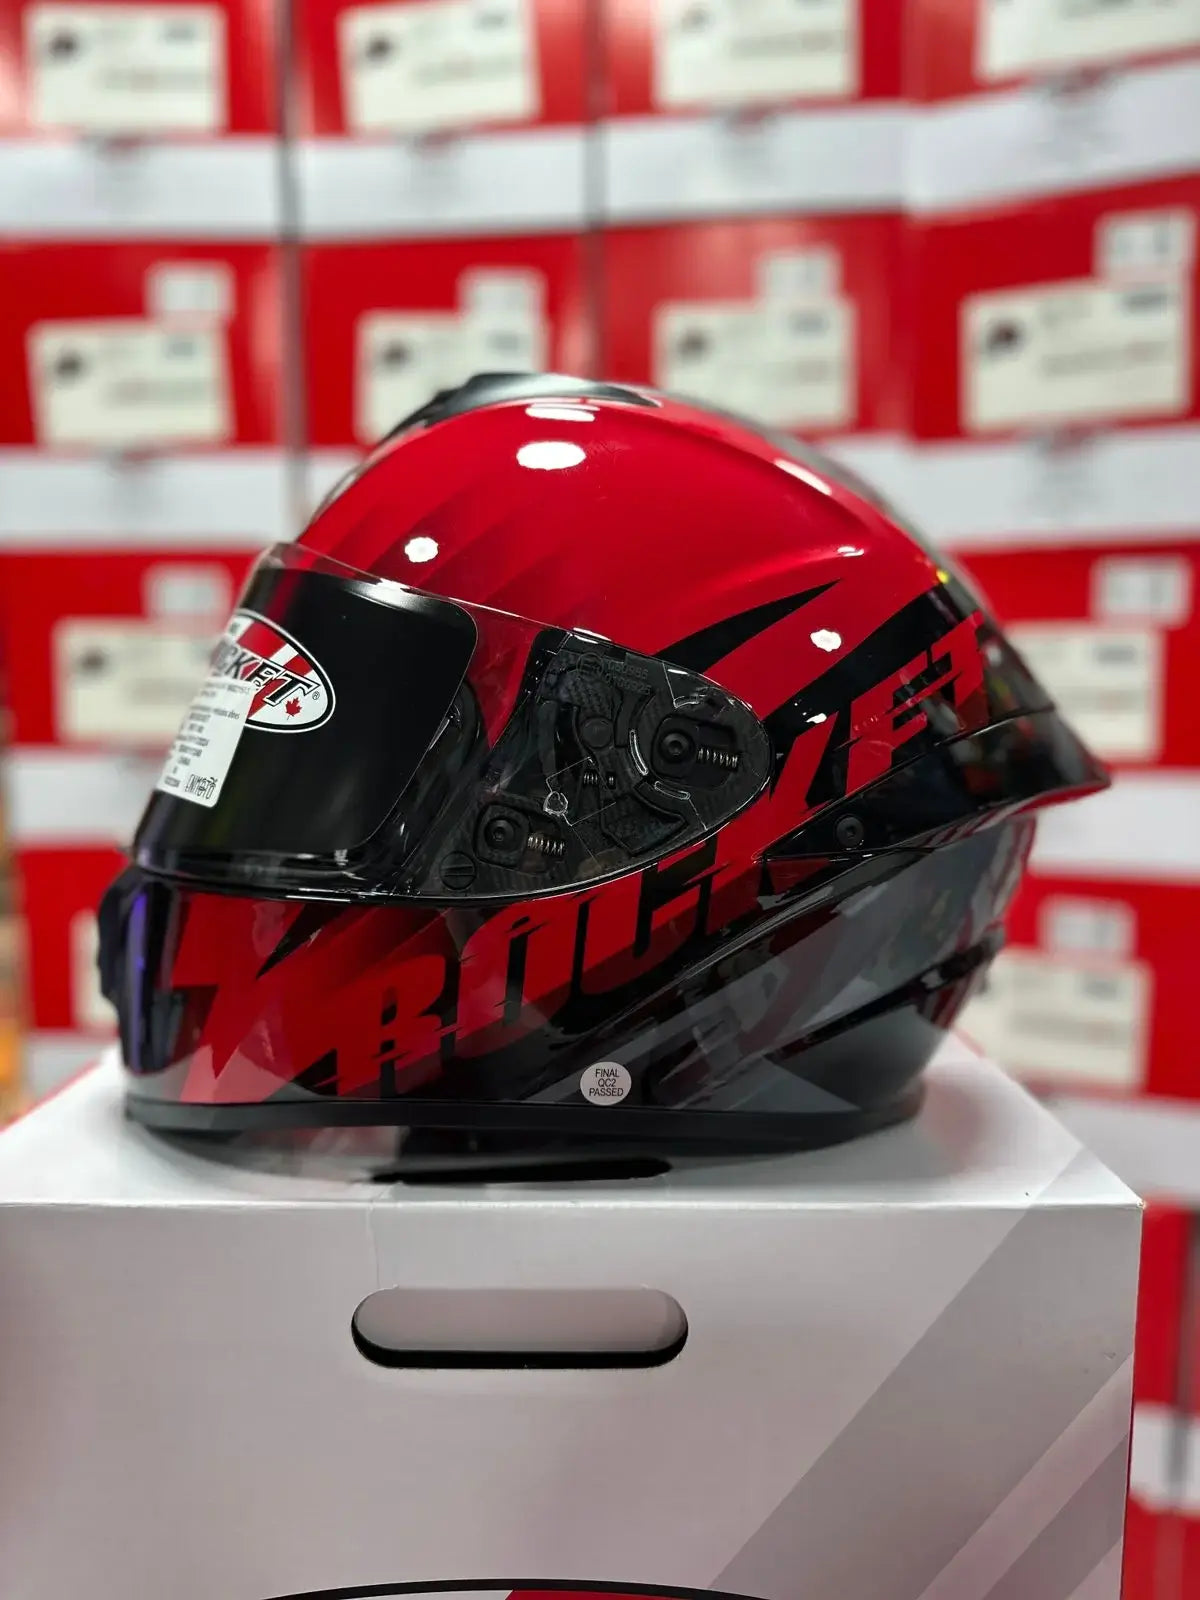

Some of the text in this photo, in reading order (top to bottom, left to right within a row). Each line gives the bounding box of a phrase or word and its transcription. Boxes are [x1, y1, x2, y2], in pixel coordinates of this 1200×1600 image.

[595, 1068, 620, 1078] FINAL
[597, 1078, 617, 1088] QC2
[588, 1087, 624, 1097] PASSED
